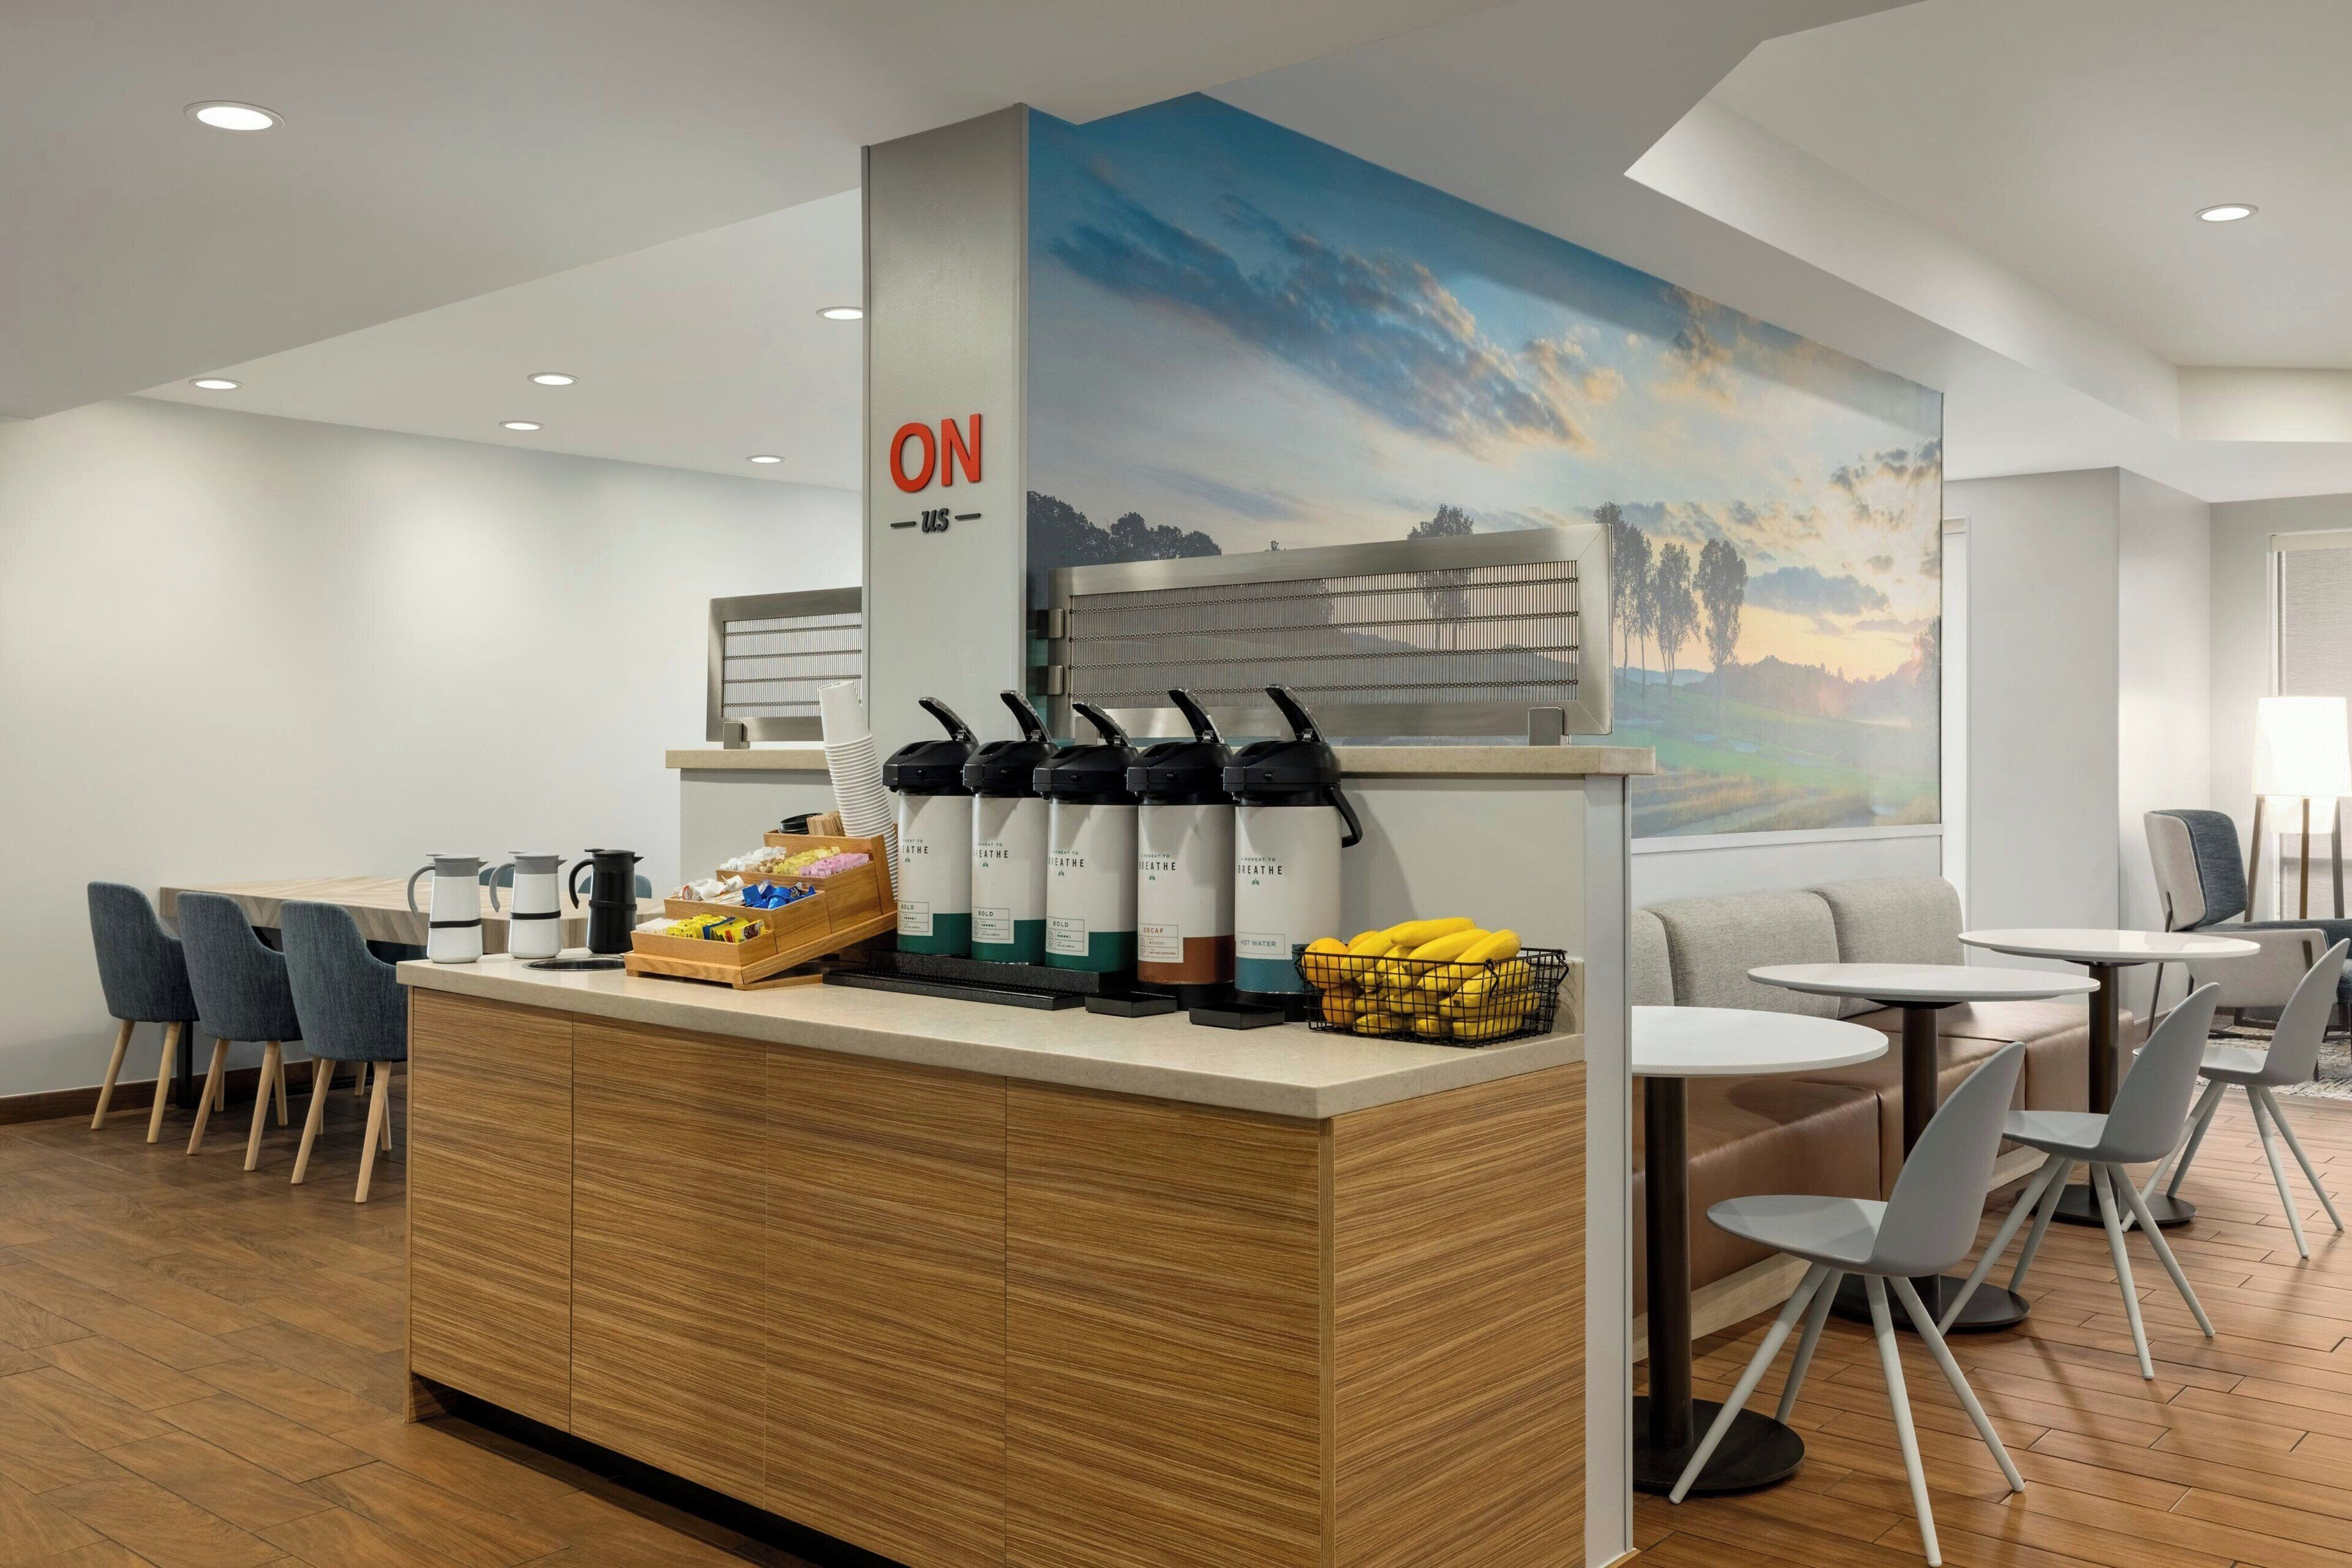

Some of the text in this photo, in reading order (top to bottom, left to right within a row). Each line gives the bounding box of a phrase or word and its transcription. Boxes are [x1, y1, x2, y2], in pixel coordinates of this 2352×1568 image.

[890, 413, 981, 493] ON
[921, 508, 949, 533] us
[1238, 864, 1283, 875] BREATHE
